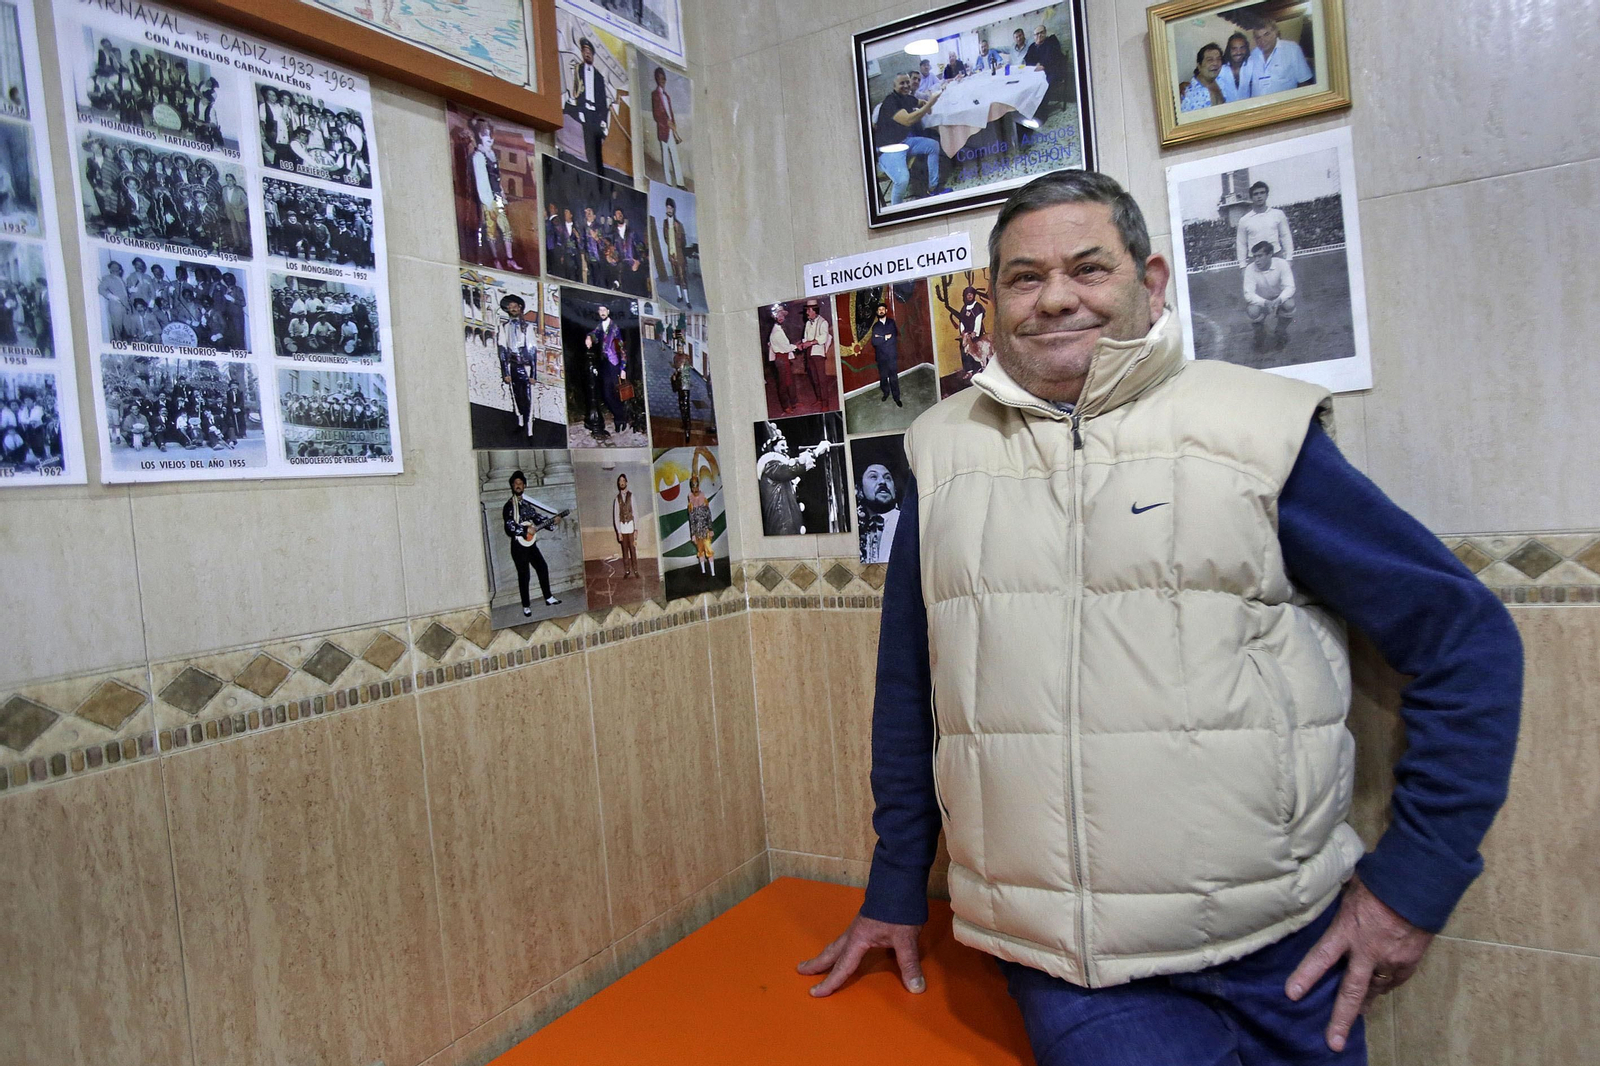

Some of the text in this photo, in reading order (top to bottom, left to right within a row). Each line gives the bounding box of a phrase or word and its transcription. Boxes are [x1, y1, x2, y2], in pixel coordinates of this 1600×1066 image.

[144, 31, 312, 91] CON ANTIGUOS CARNAVALEROS
[196, 30, 209, 44] DE
[220, 33, 271, 64] CADIZ
[280, 55, 315, 79] 1932
[78, 113, 241, 159] LOS HOJALATEROS TARTAJOSOS 1959
[957, 140, 1008, 162] Comida
[280, 160, 294, 171] LOS
[3, 222, 27, 234] 1935
[105, 234, 238, 262] LOS CHARROS MEJICANOS 1954
[286, 261, 368, 280] LOS MONOSABIOS 1952
[812, 246, 967, 288] EL RINCÓN DEL CHATO
[0, 346, 41, 356] ERBENA
[112, 340, 248, 359] LOS RIDICULOS TENORIOS 1957
[4, 356, 28, 365] 1958
[293, 353, 374, 366] LOS COQUINEROS 1951
[141, 457, 246, 469] LOS VIEJOS DEL AÑO 1955
[290, 456, 333, 465] GONDOLEROS
[334, 456, 342, 464] DE
[380, 455, 394, 463] 1950
[39, 467, 62, 477] 1962
